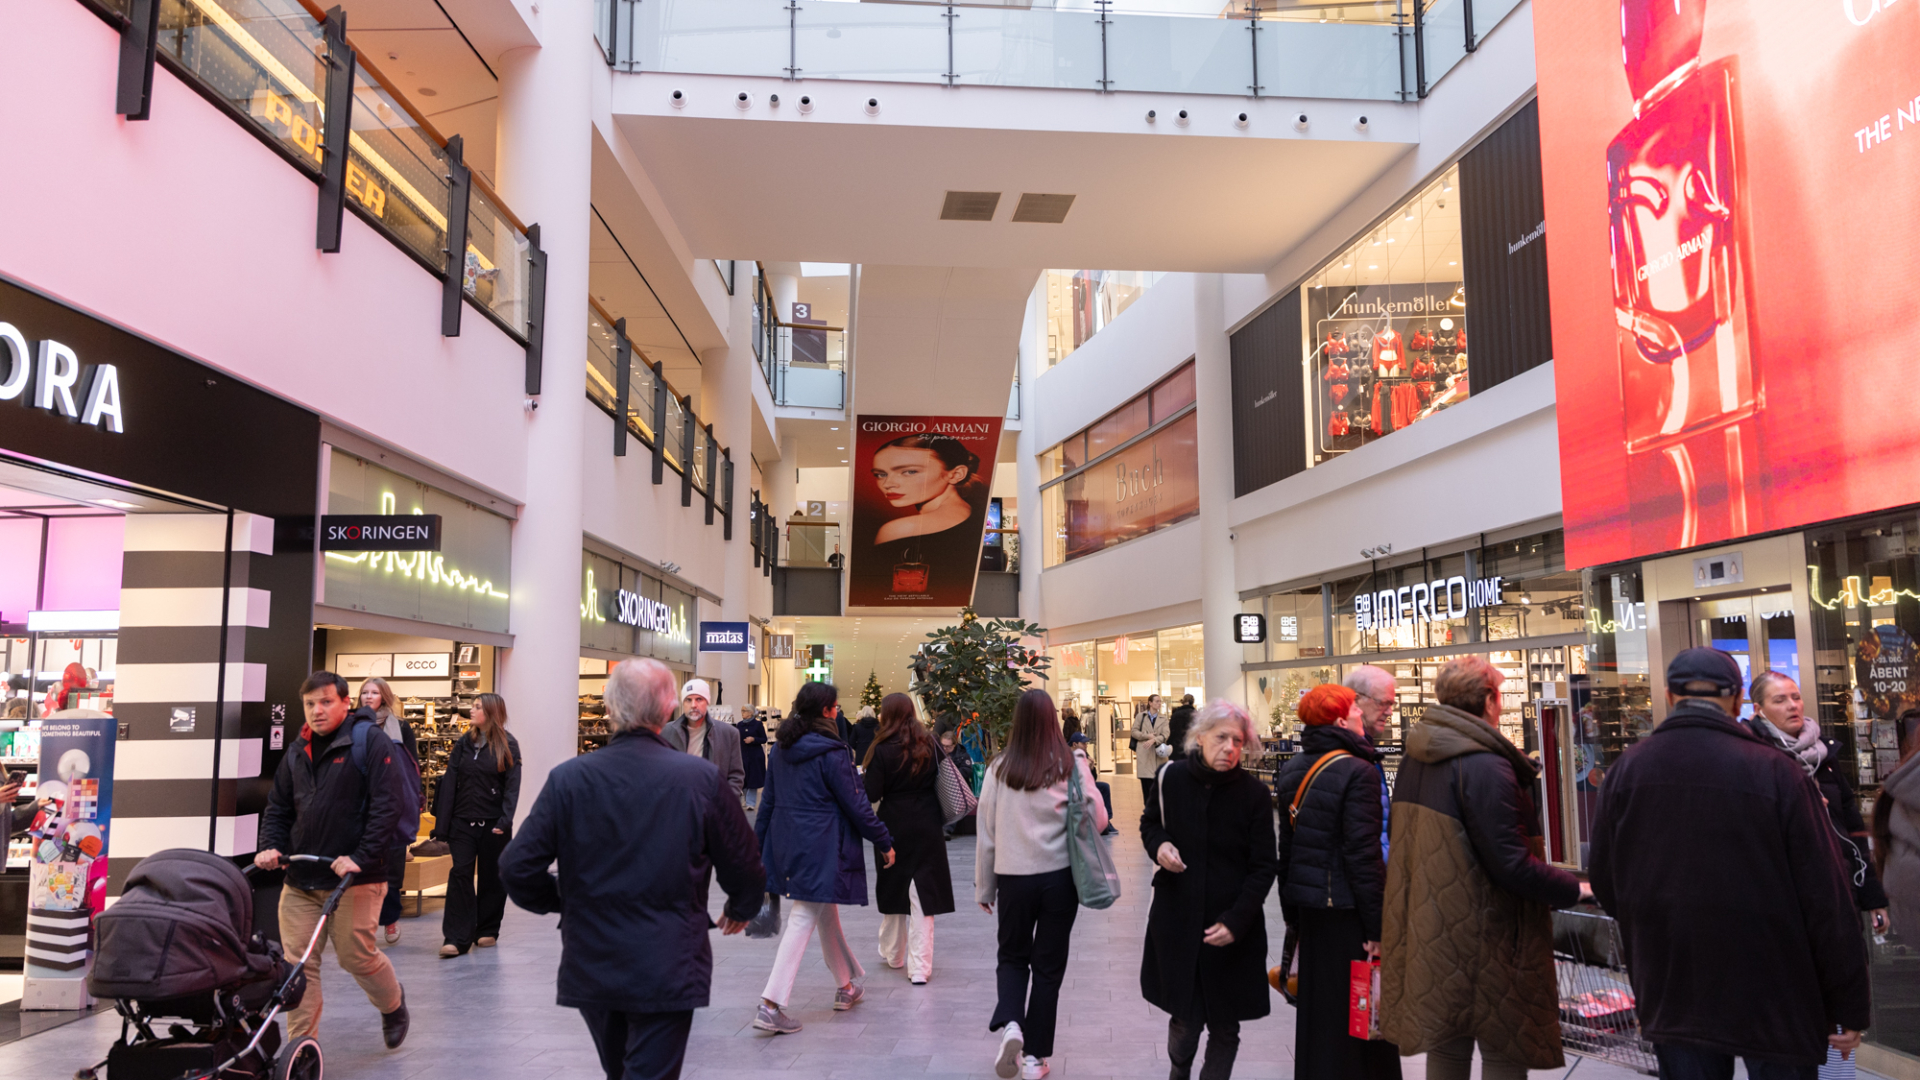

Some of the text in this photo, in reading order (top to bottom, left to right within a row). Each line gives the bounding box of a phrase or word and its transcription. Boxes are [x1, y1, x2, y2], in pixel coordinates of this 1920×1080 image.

[1854, 114, 1892, 154] THE
[263, 88, 386, 219] POER
[795, 304, 808, 319] 3
[1342, 295, 1452, 315] hunkemöller
[862, 421, 990, 434] GIORGIO ARMANI
[930, 435, 988, 444] passione
[1115, 444, 1164, 505] Buch
[810, 502, 823, 517] 2
[328, 525, 429, 541] SKORINGEN
[1372, 575, 1503, 630] IMERCO HOME
[618, 588, 672, 635] SKORINGEN
[705, 630, 744, 644] matas
[406, 660, 438, 670] ecco
[1870, 664, 1909, 679] ÅBENT
[1873, 681, 1907, 693] 10-20
